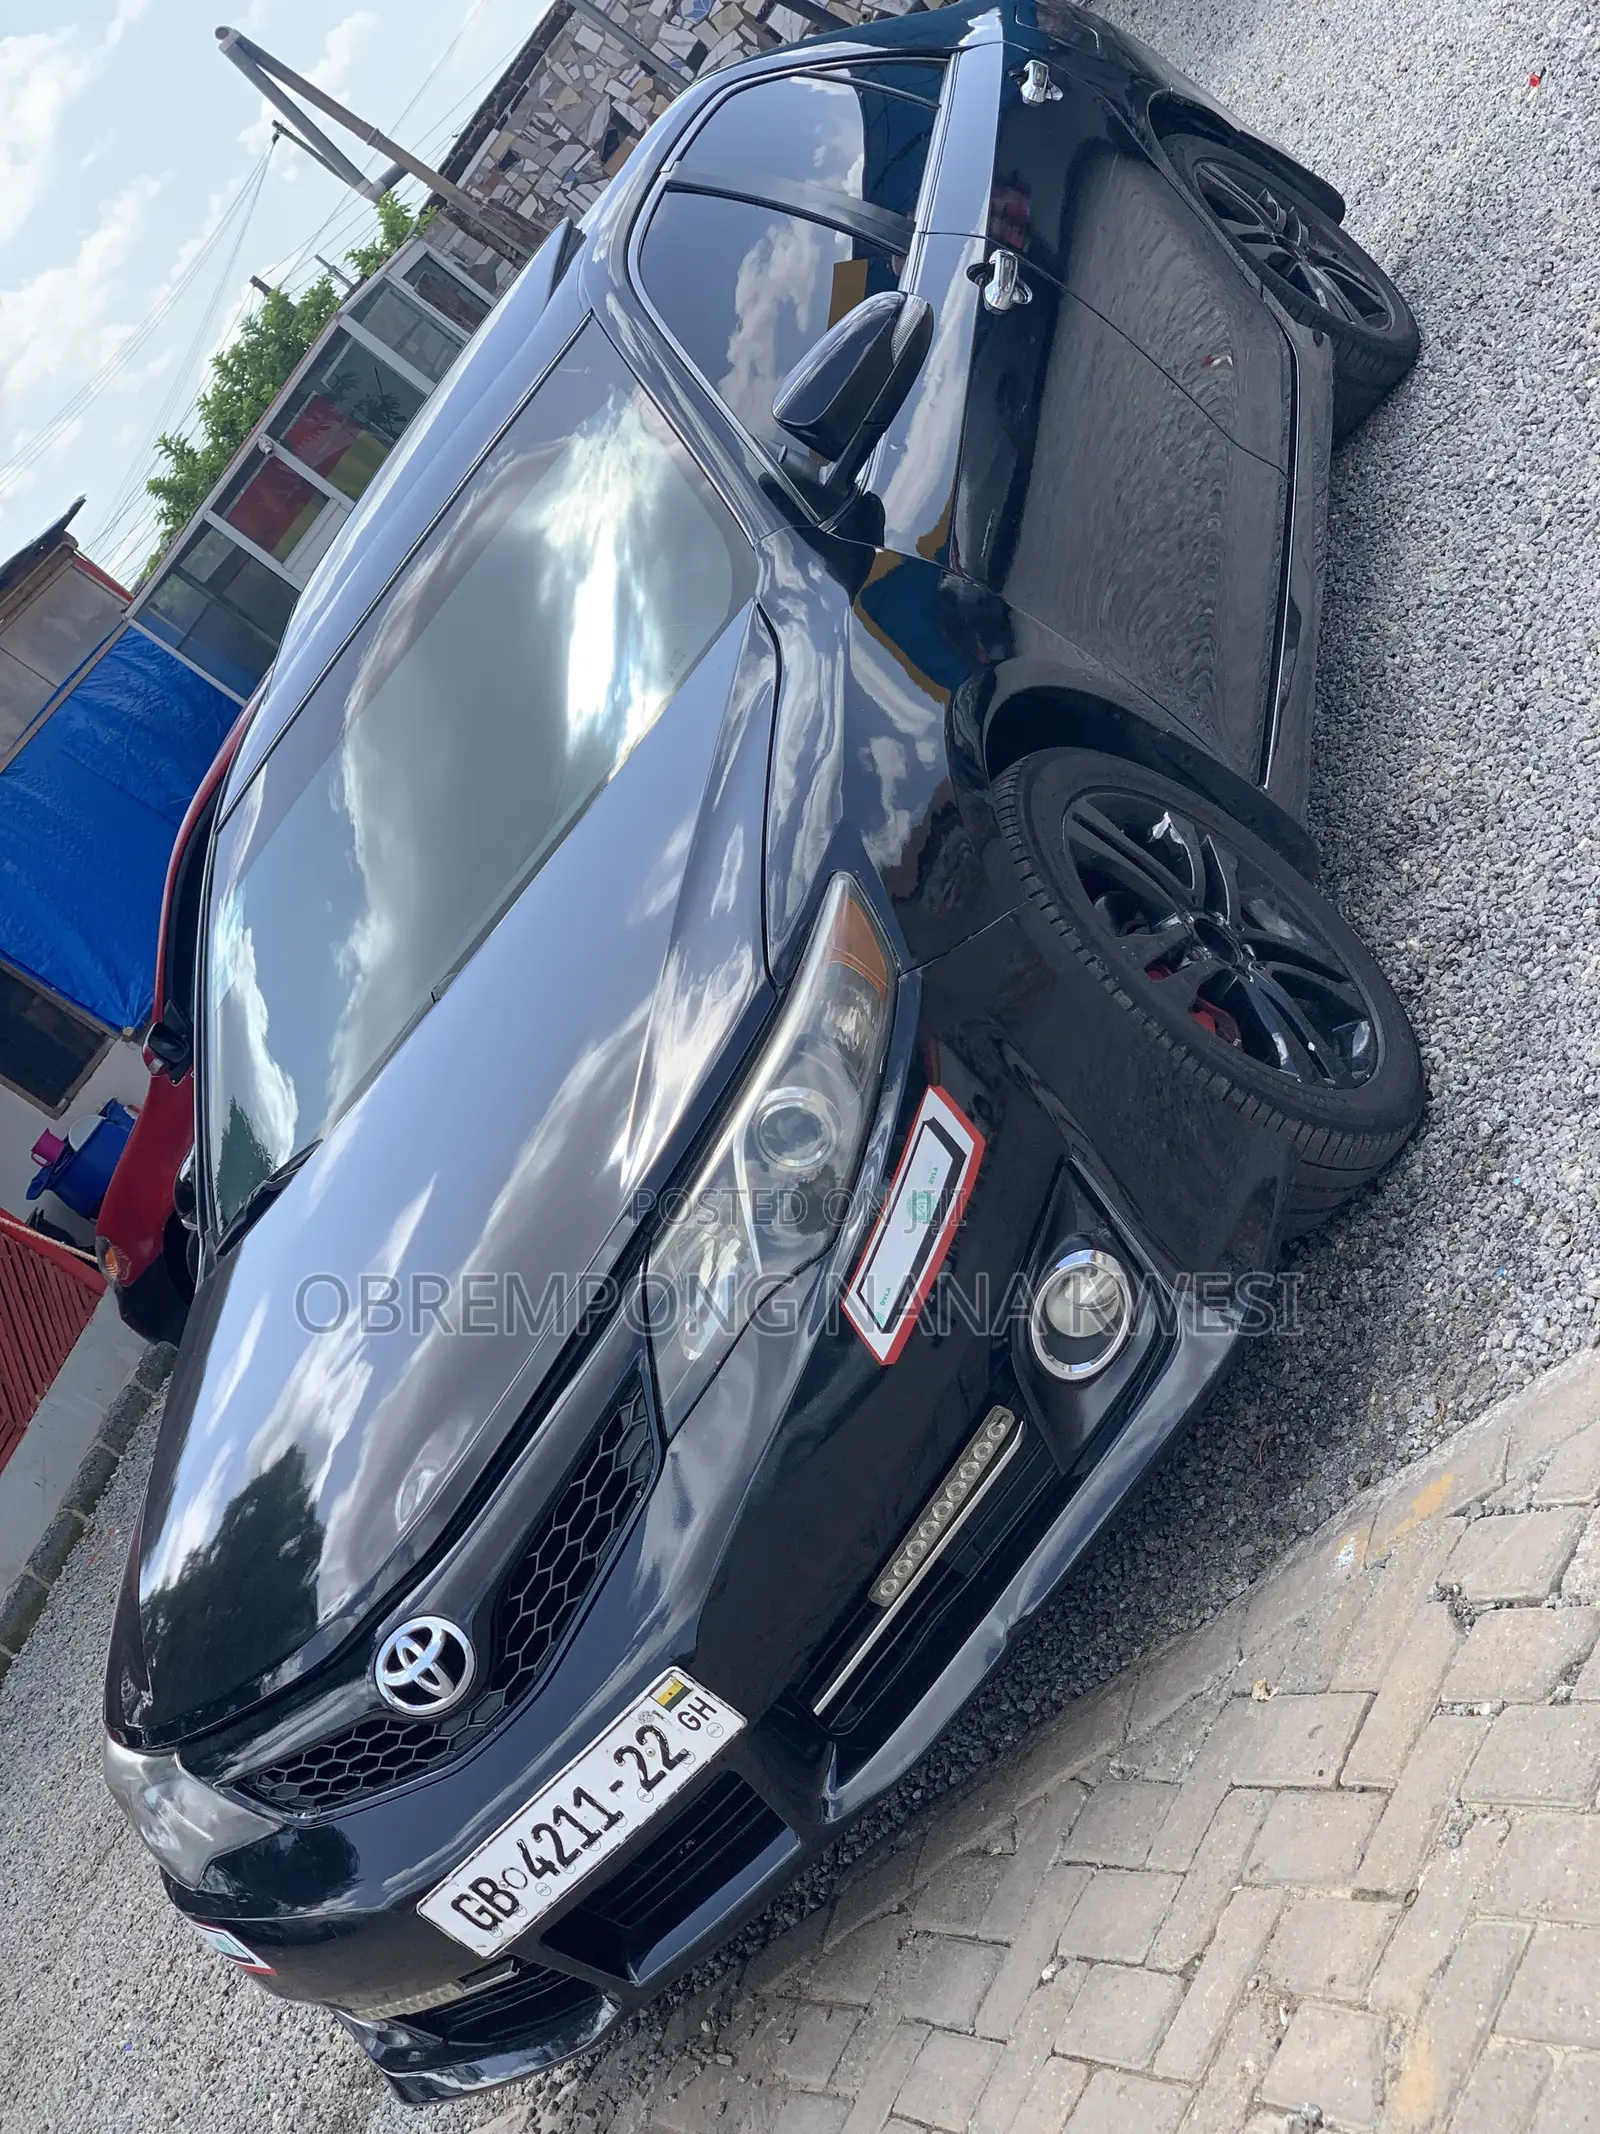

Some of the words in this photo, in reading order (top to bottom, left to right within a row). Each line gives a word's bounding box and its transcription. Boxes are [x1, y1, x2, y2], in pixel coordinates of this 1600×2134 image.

[928, 1166, 939, 1185] DVLA
[880, 1287, 891, 1306] DVLA
[677, 1696, 717, 1731] GH
[450, 1876, 520, 1931] GB
